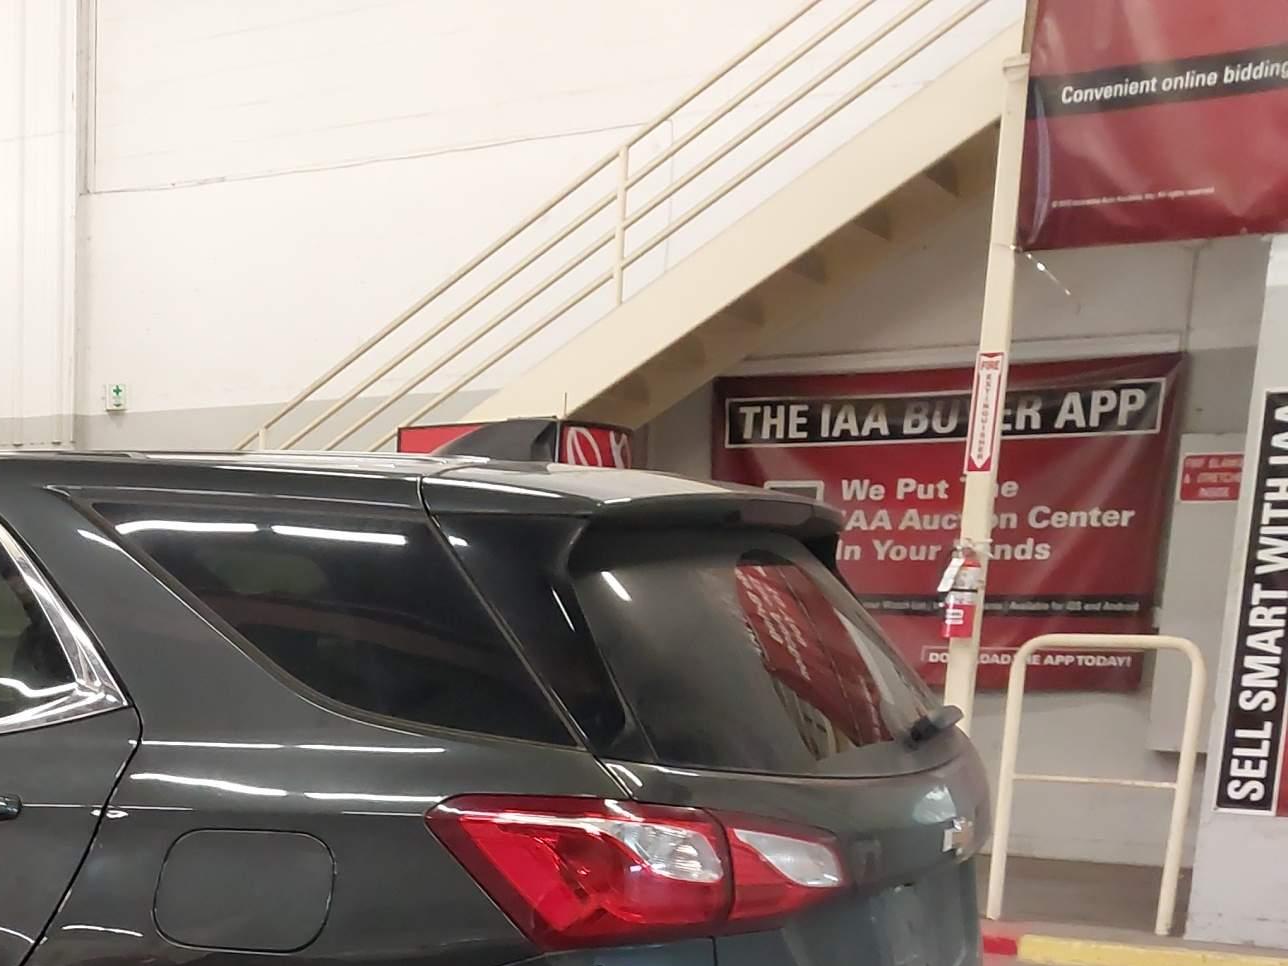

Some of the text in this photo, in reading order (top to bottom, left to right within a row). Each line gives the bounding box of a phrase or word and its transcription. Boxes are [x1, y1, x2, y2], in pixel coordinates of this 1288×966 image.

[1062, 77, 1157, 104] Convenient
[1162, 70, 1217, 91] online
[739, 404, 809, 439] THE
[820, 403, 890, 438] IAA
[1054, 388, 1147, 428] APP
[841, 479, 886, 500] We
[896, 478, 950, 500] Put
[842, 509, 893, 531] AA
[1027, 505, 1136, 529] Center
[1255, 477, 1288, 575] WITH
[835, 539, 861, 561] In
[872, 539, 942, 561] Your
[1044, 654, 1074, 666] APP
[1238, 583, 1288, 712] SMART
[1227, 721, 1273, 801] SELL
